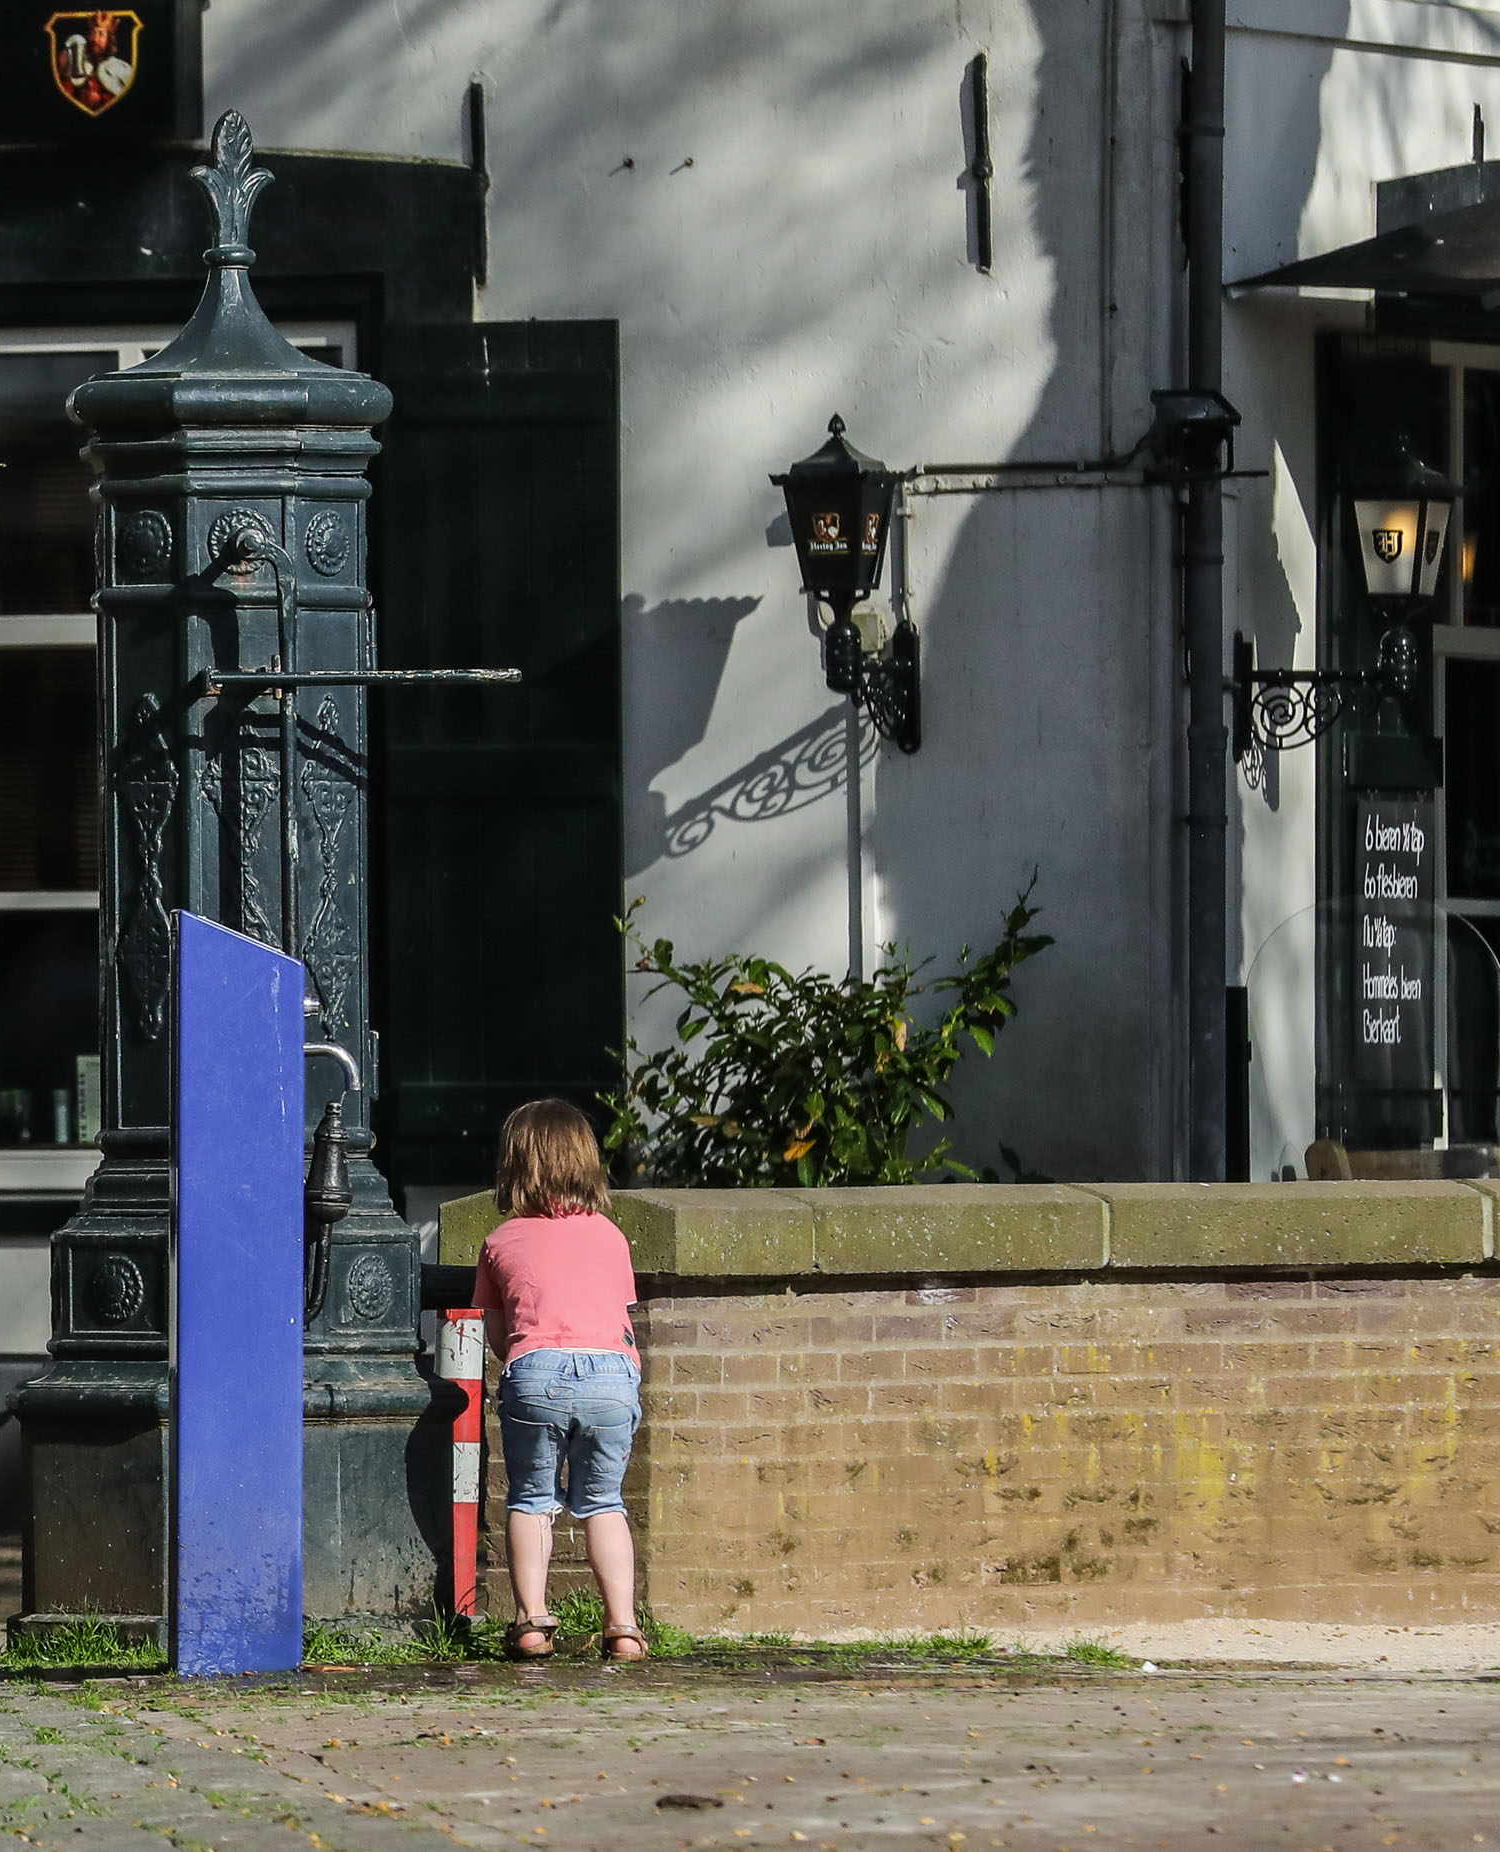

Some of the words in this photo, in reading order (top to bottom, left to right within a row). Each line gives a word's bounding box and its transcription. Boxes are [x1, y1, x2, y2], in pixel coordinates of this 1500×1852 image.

[1365, 813, 1374, 852] 6
[1375, 813, 1401, 852] bieren
[1410, 820, 1425, 867] tap
[1376, 862, 1418, 899] flesbieren
[1401, 963, 1421, 1000] bieren
[1363, 1004, 1402, 1044] Bierkaart
